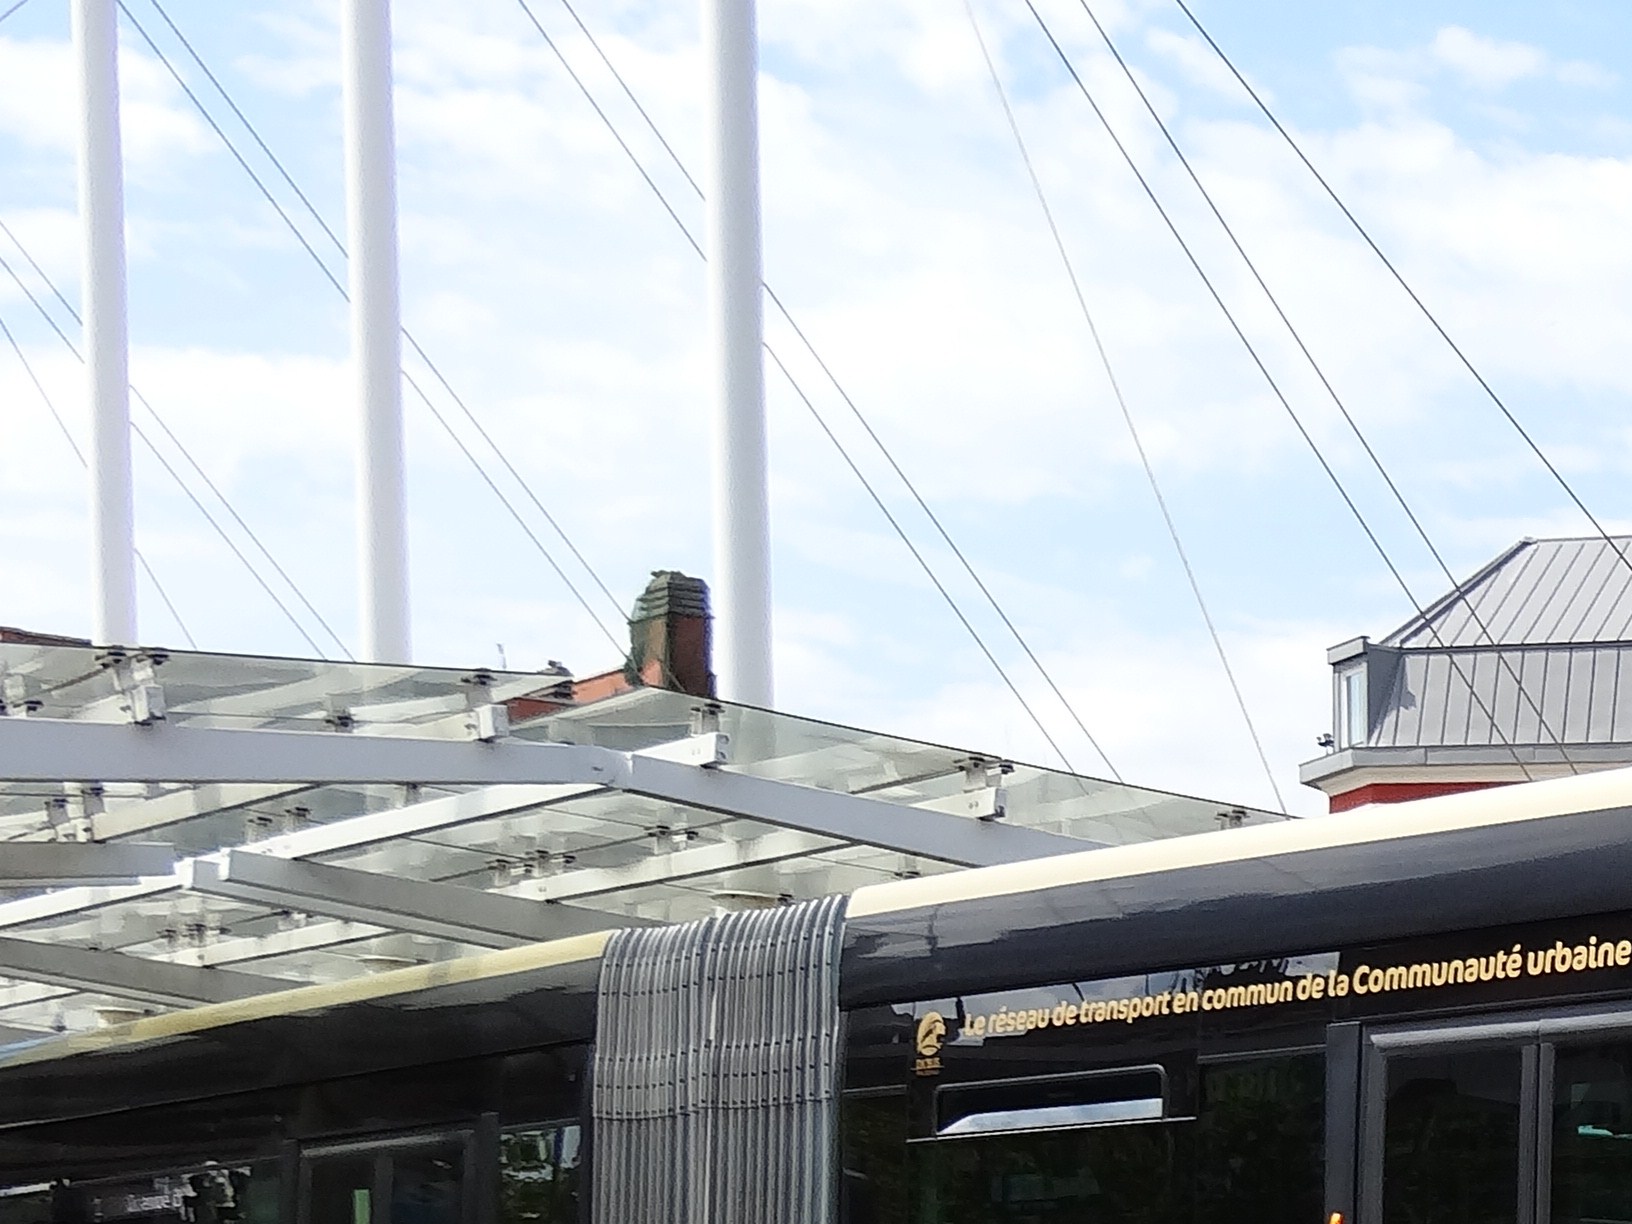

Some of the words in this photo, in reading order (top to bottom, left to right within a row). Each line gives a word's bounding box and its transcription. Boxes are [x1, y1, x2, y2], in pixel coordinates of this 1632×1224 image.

[964, 1013, 985, 1037] Le
[988, 1005, 1049, 1035] réseau
[1052, 1000, 1077, 1028] de
[1080, 991, 1170, 1025] transport
[1173, 991, 1198, 1014] en
[1201, 980, 1293, 1011] commun
[1296, 973, 1323, 1001] de
[1327, 971, 1349, 997] la
[1352, 943, 1522, 995] Communauté
[1527, 936, 1631, 976] urbaine
